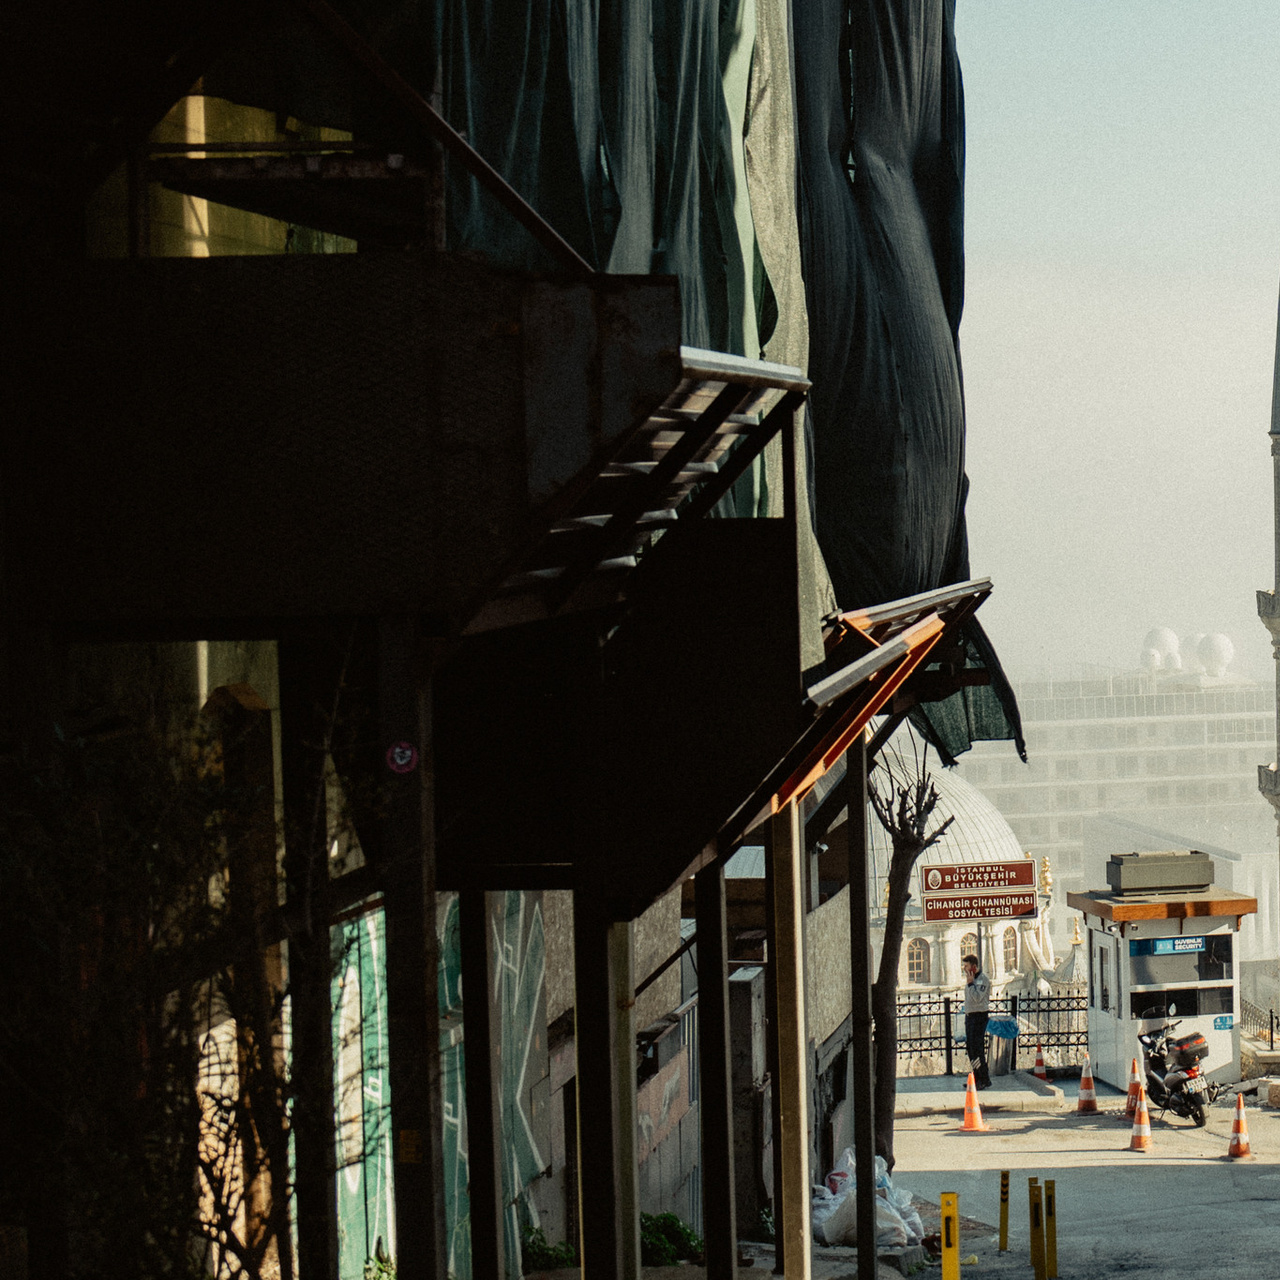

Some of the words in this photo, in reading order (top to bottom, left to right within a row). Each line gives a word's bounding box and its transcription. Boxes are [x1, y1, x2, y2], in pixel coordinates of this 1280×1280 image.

[956, 865, 1005, 873] İSTANBUL
[945, 871, 1017, 882] BÜYÜKŞEHİR
[954, 880, 1009, 888] BELEDİYESİ
[927, 899, 970, 909] CİHANGİR
[972, 896, 1033, 907] CİHANNÜMASI
[948, 909, 983, 918] SOSYAL
[984, 906, 1013, 916] TESİSİ
[1174, 943, 1203, 951] SECURITY
